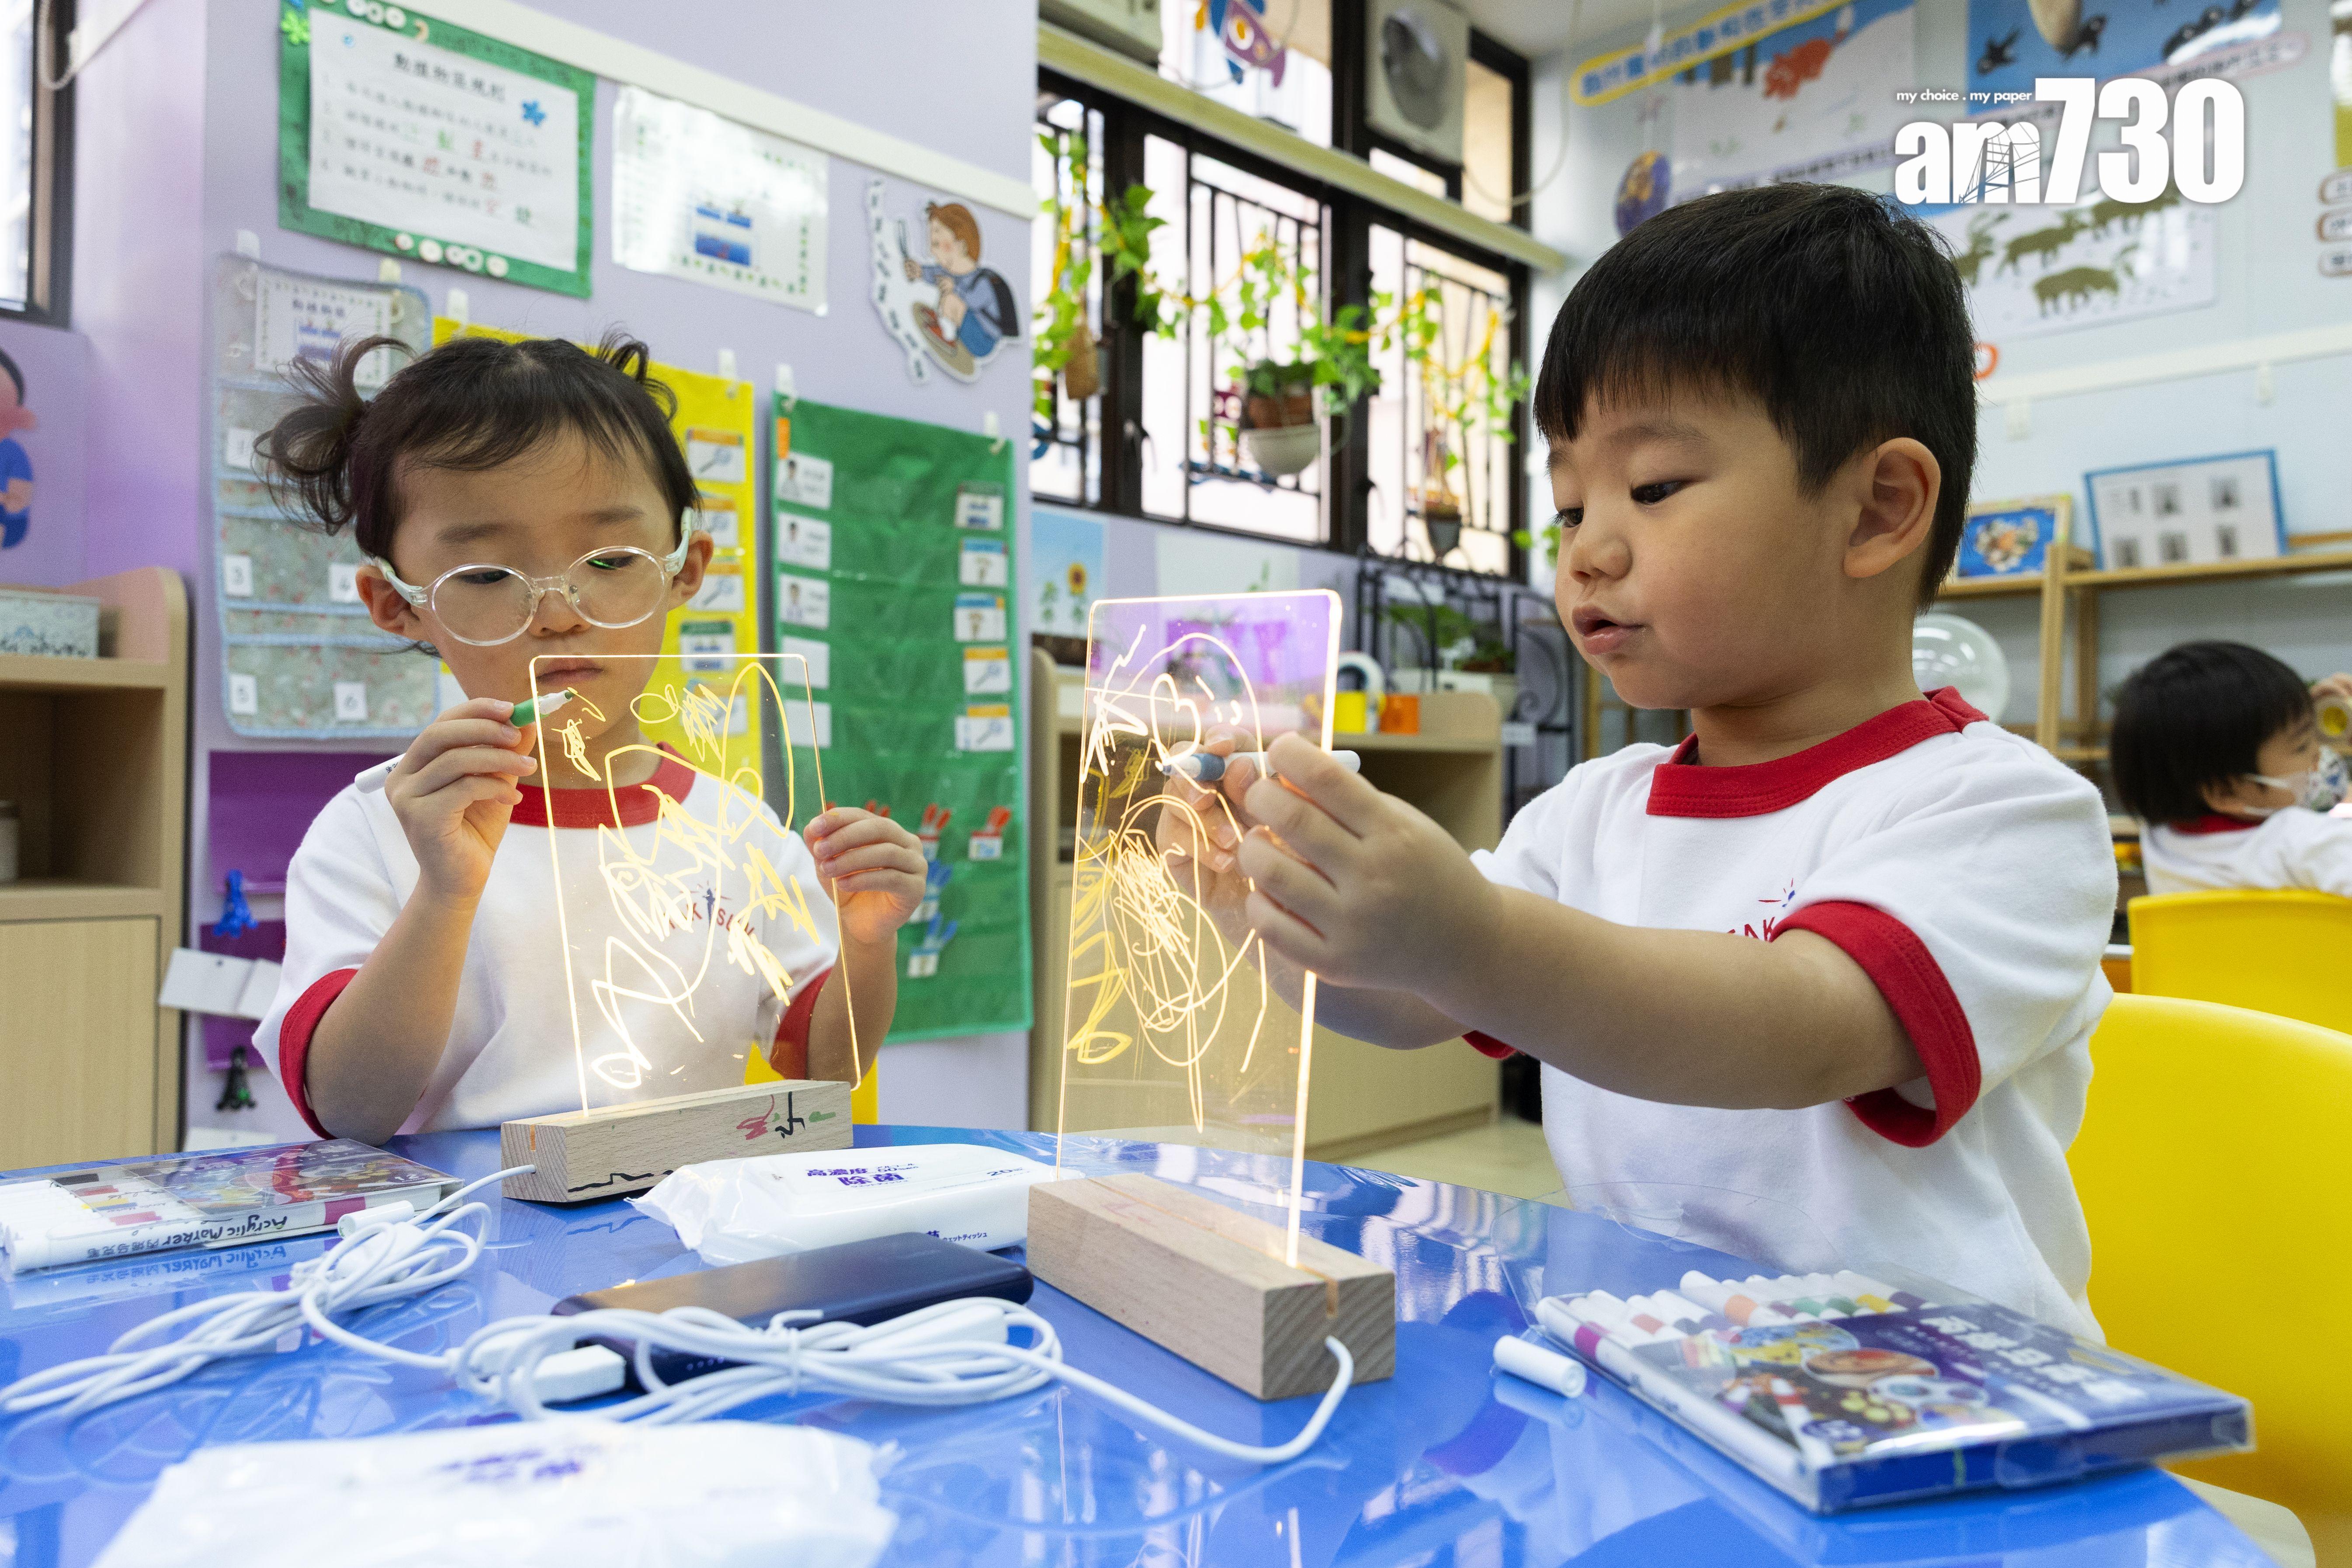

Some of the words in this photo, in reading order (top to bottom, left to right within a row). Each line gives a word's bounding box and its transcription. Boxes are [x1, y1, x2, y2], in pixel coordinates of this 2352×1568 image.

[837, 1173, 904, 1186] 除菌
[227, 1214, 288, 1235] Acrylic
[87, 1238, 159, 1258] 丙烯马克笔
